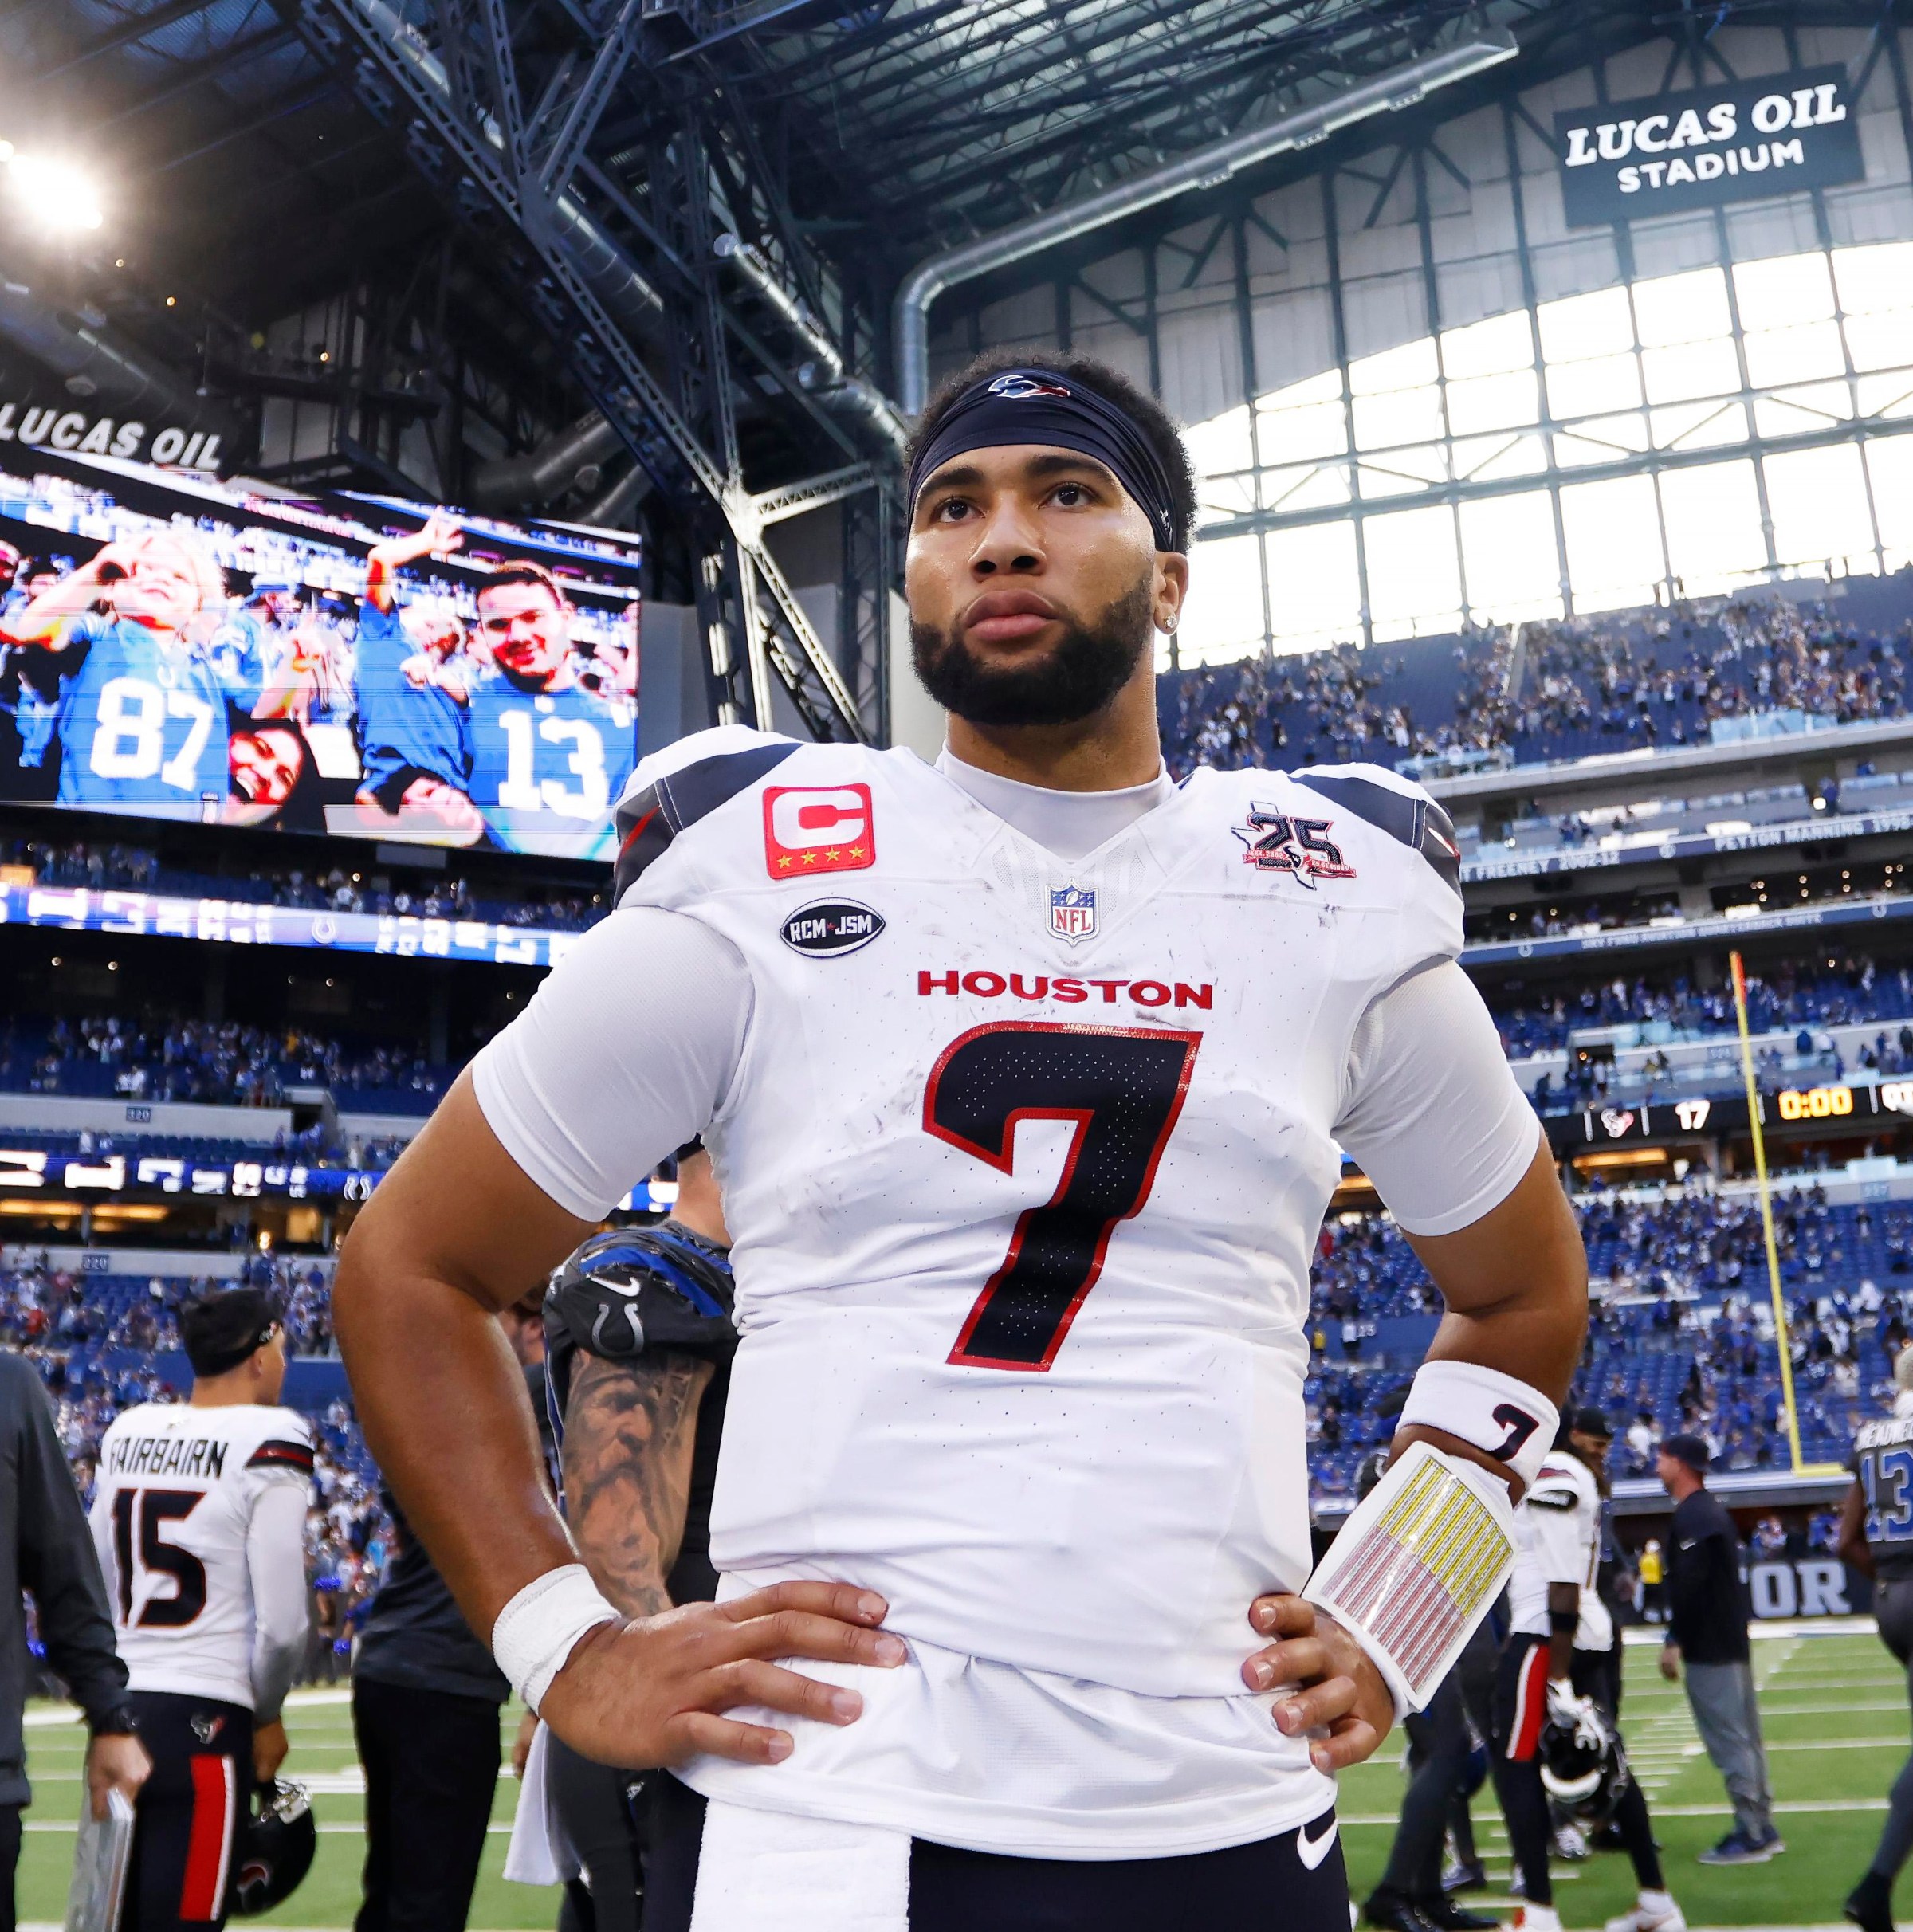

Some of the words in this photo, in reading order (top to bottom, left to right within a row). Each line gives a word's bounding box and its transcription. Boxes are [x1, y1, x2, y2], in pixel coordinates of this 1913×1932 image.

[1565, 103, 1738, 167] LUCAS
[1751, 84, 1847, 133] OIL
[1618, 139, 1805, 193] STADIUM
[0, 402, 147, 458] LUCAS
[151, 426, 223, 471] OIL
[89, 677, 214, 793] 87
[498, 709, 610, 823] 13
[772, 789, 866, 850] C
[1247, 811, 1347, 876] 25
[790, 918, 827, 943] RCM
[835, 914, 872, 936] JSM
[1055, 908, 1091, 933] NFL
[918, 970, 1212, 1010] HOUSTON
[1675, 1099, 1711, 1130] 17
[1778, 1086, 1854, 1121] 0:00
[922, 1020, 1204, 1372] 7
[110, 1436, 229, 1480] FAIRBAIRN
[1491, 1404, 1540, 1462] 7
[1860, 1443, 1913, 1542] 13
[112, 1488, 207, 1629] 15
[1738, 1560, 1852, 1619] OR
